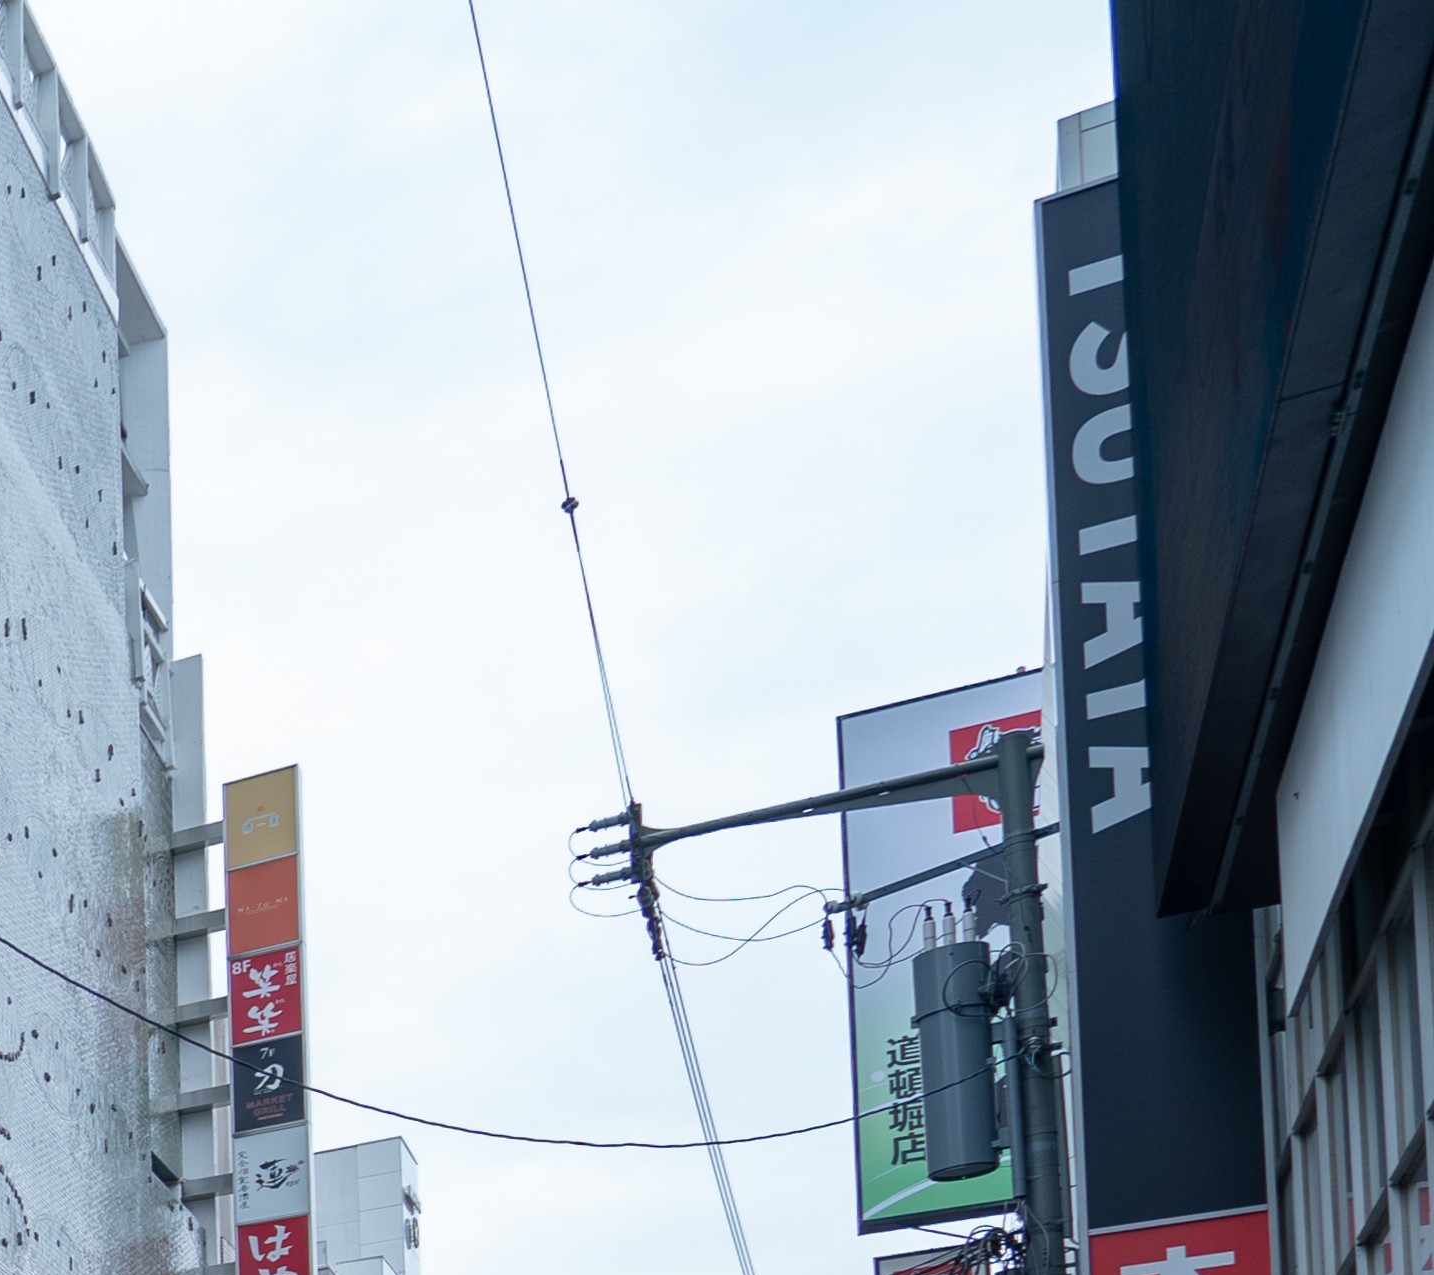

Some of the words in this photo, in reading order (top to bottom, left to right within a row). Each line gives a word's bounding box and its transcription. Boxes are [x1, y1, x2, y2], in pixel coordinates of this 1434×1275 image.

[232, 959, 251, 975] 8F
[246, 1093, 293, 1109] MARKET
[253, 1104, 287, 1117] GRILL
